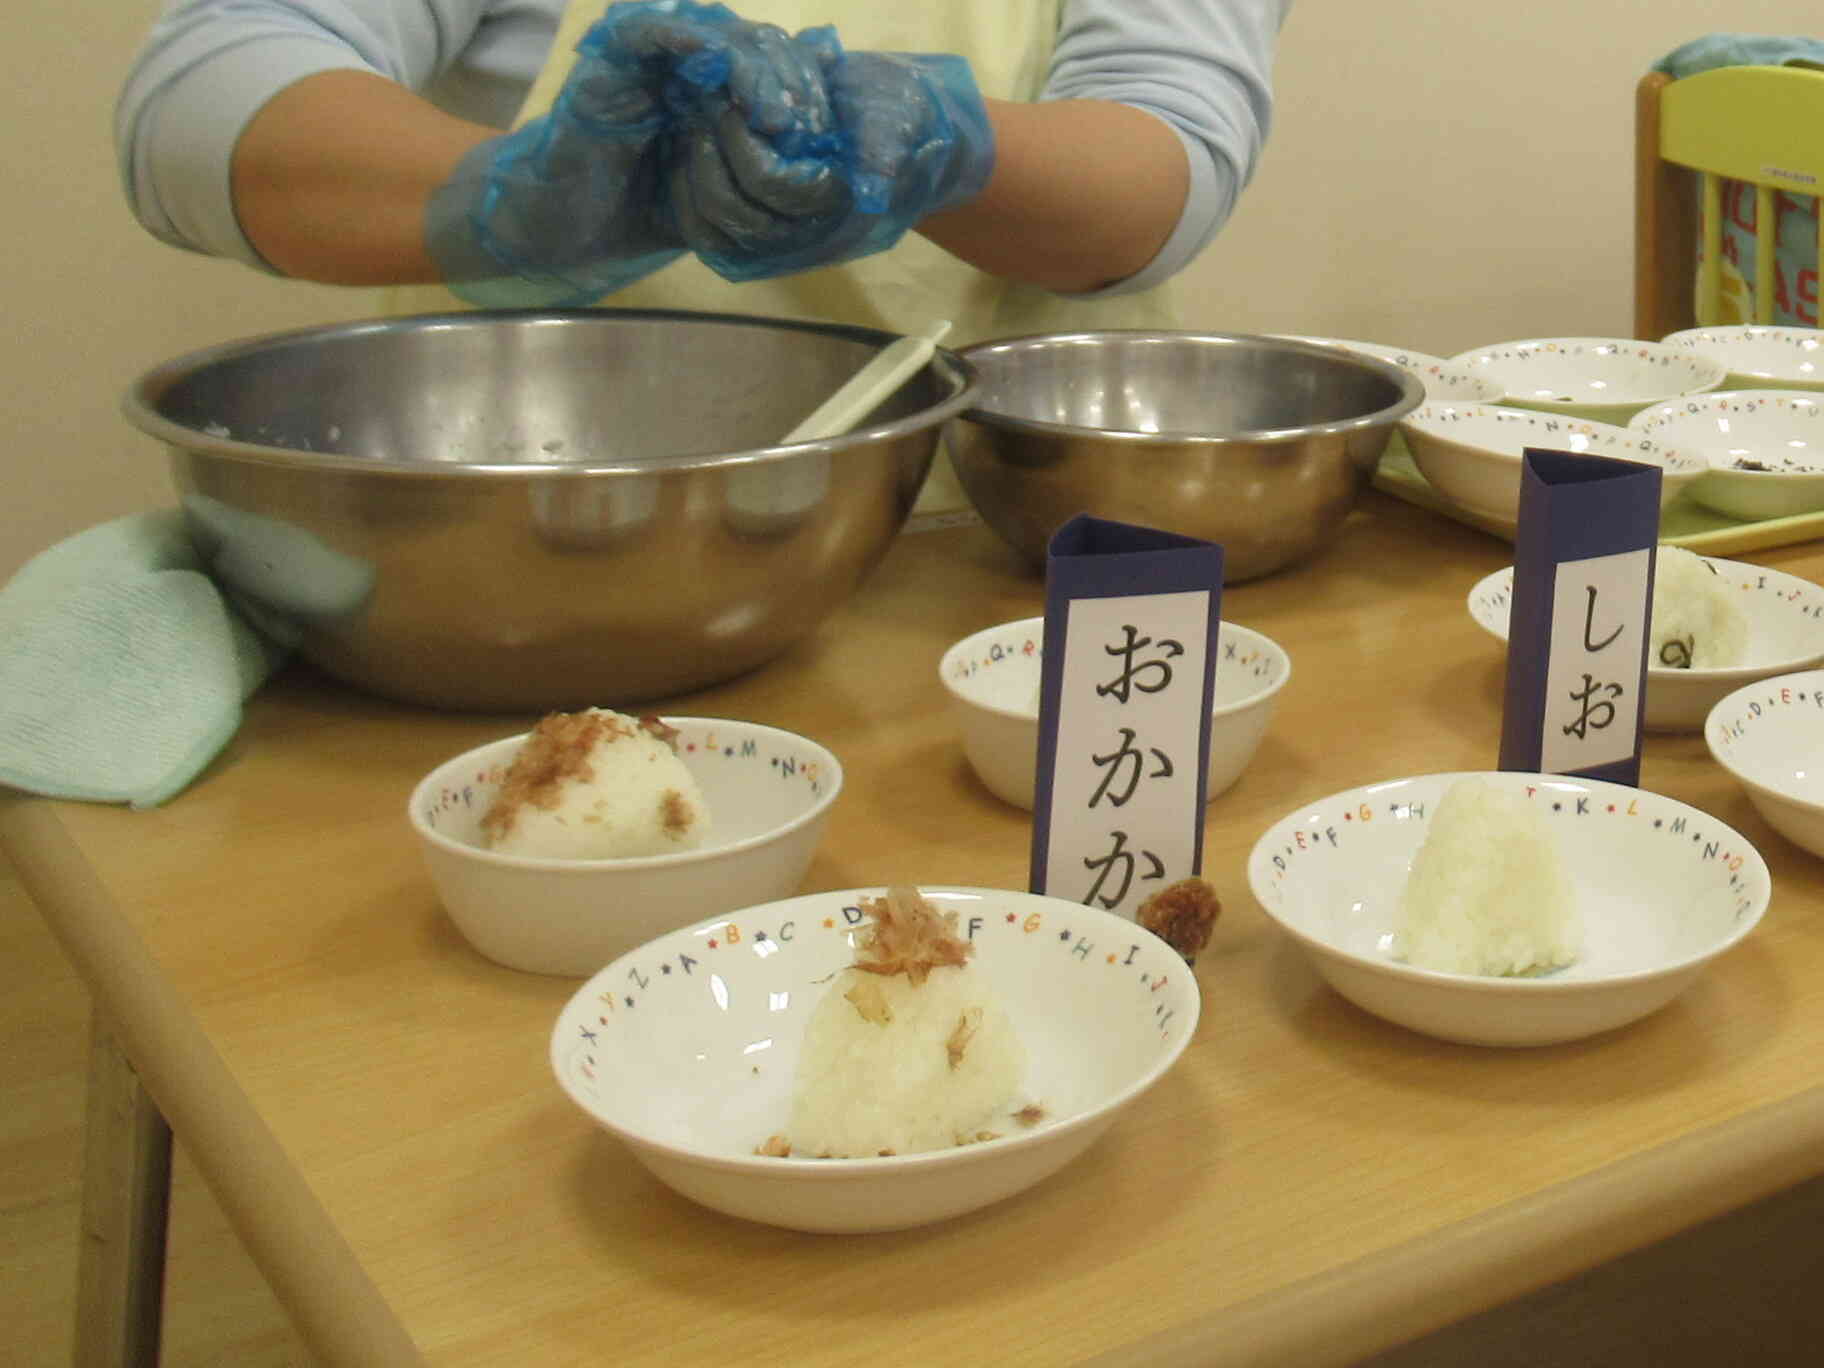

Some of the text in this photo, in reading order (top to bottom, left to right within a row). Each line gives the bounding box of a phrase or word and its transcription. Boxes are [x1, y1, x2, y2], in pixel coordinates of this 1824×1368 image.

[1083, 624, 1185, 911] おかか
[1562, 585, 1625, 740] しお
